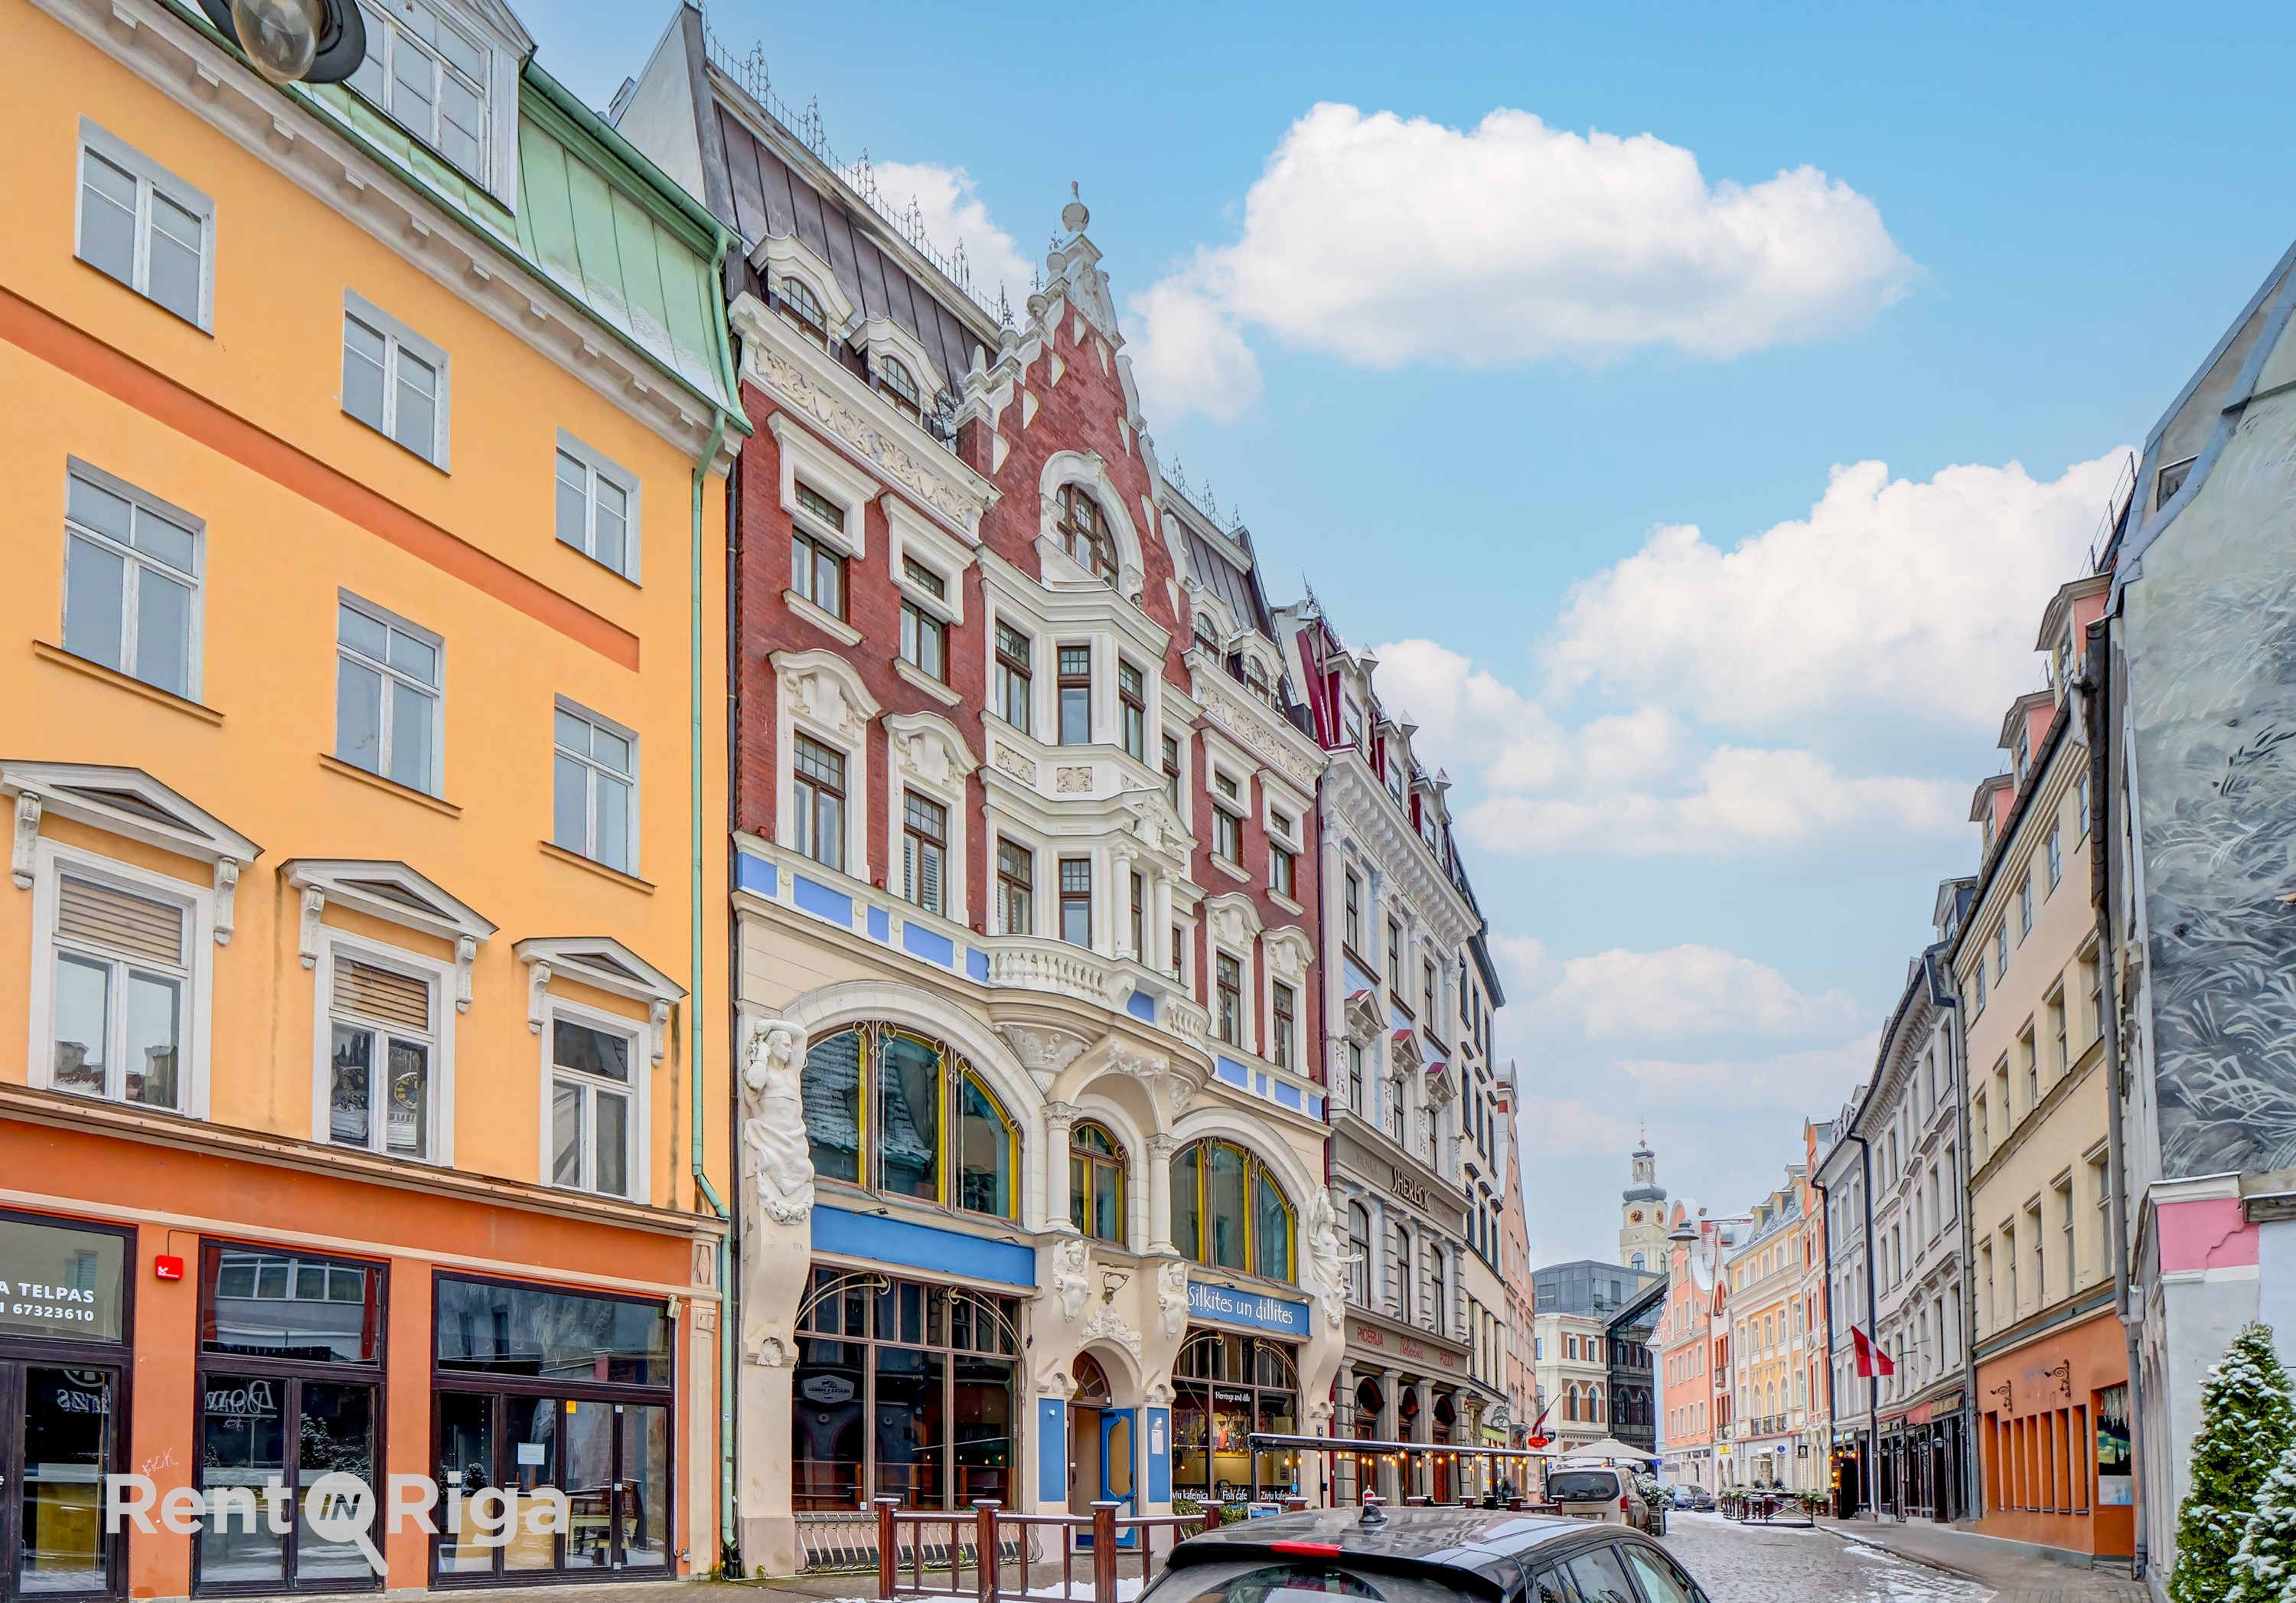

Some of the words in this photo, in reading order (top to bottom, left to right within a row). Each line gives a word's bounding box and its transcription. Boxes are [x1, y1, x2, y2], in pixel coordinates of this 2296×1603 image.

[18, 1282, 95, 1304] TELPAS
[12, 1303, 94, 1322] 67323610
[1236, 1301, 1252, 1318] un
[1357, 1326, 1384, 1347] PICĒRIJA
[1440, 1351, 1454, 1368] PIZZA
[1215, 1391, 1234, 1402] Herrings
[1234, 1393, 1242, 1402] and
[1222, 1489, 1234, 1500] Fish
[1261, 1491, 1274, 1502] Zivju
